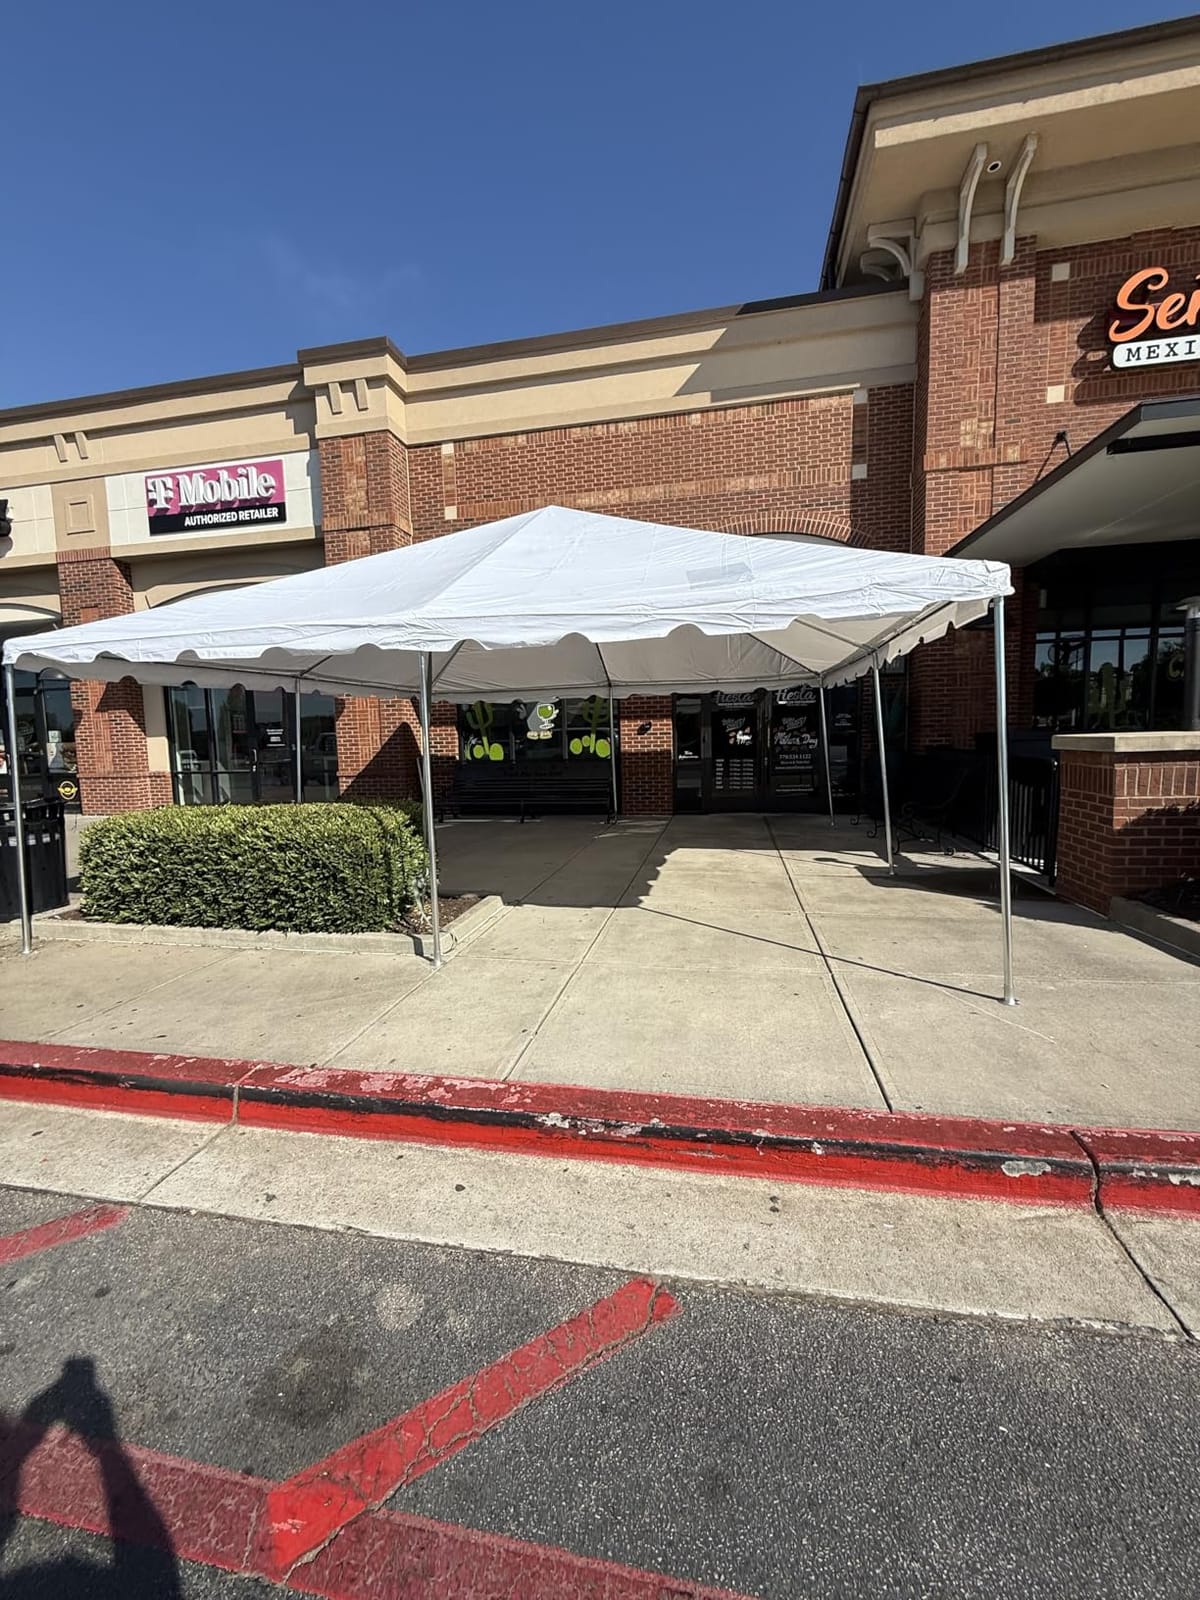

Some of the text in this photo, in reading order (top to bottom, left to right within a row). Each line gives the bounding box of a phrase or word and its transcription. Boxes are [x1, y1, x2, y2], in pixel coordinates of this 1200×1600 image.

[1125, 340, 1197, 362] MEXI
[184, 507, 278, 527] AUTHORIZED RETAILER
